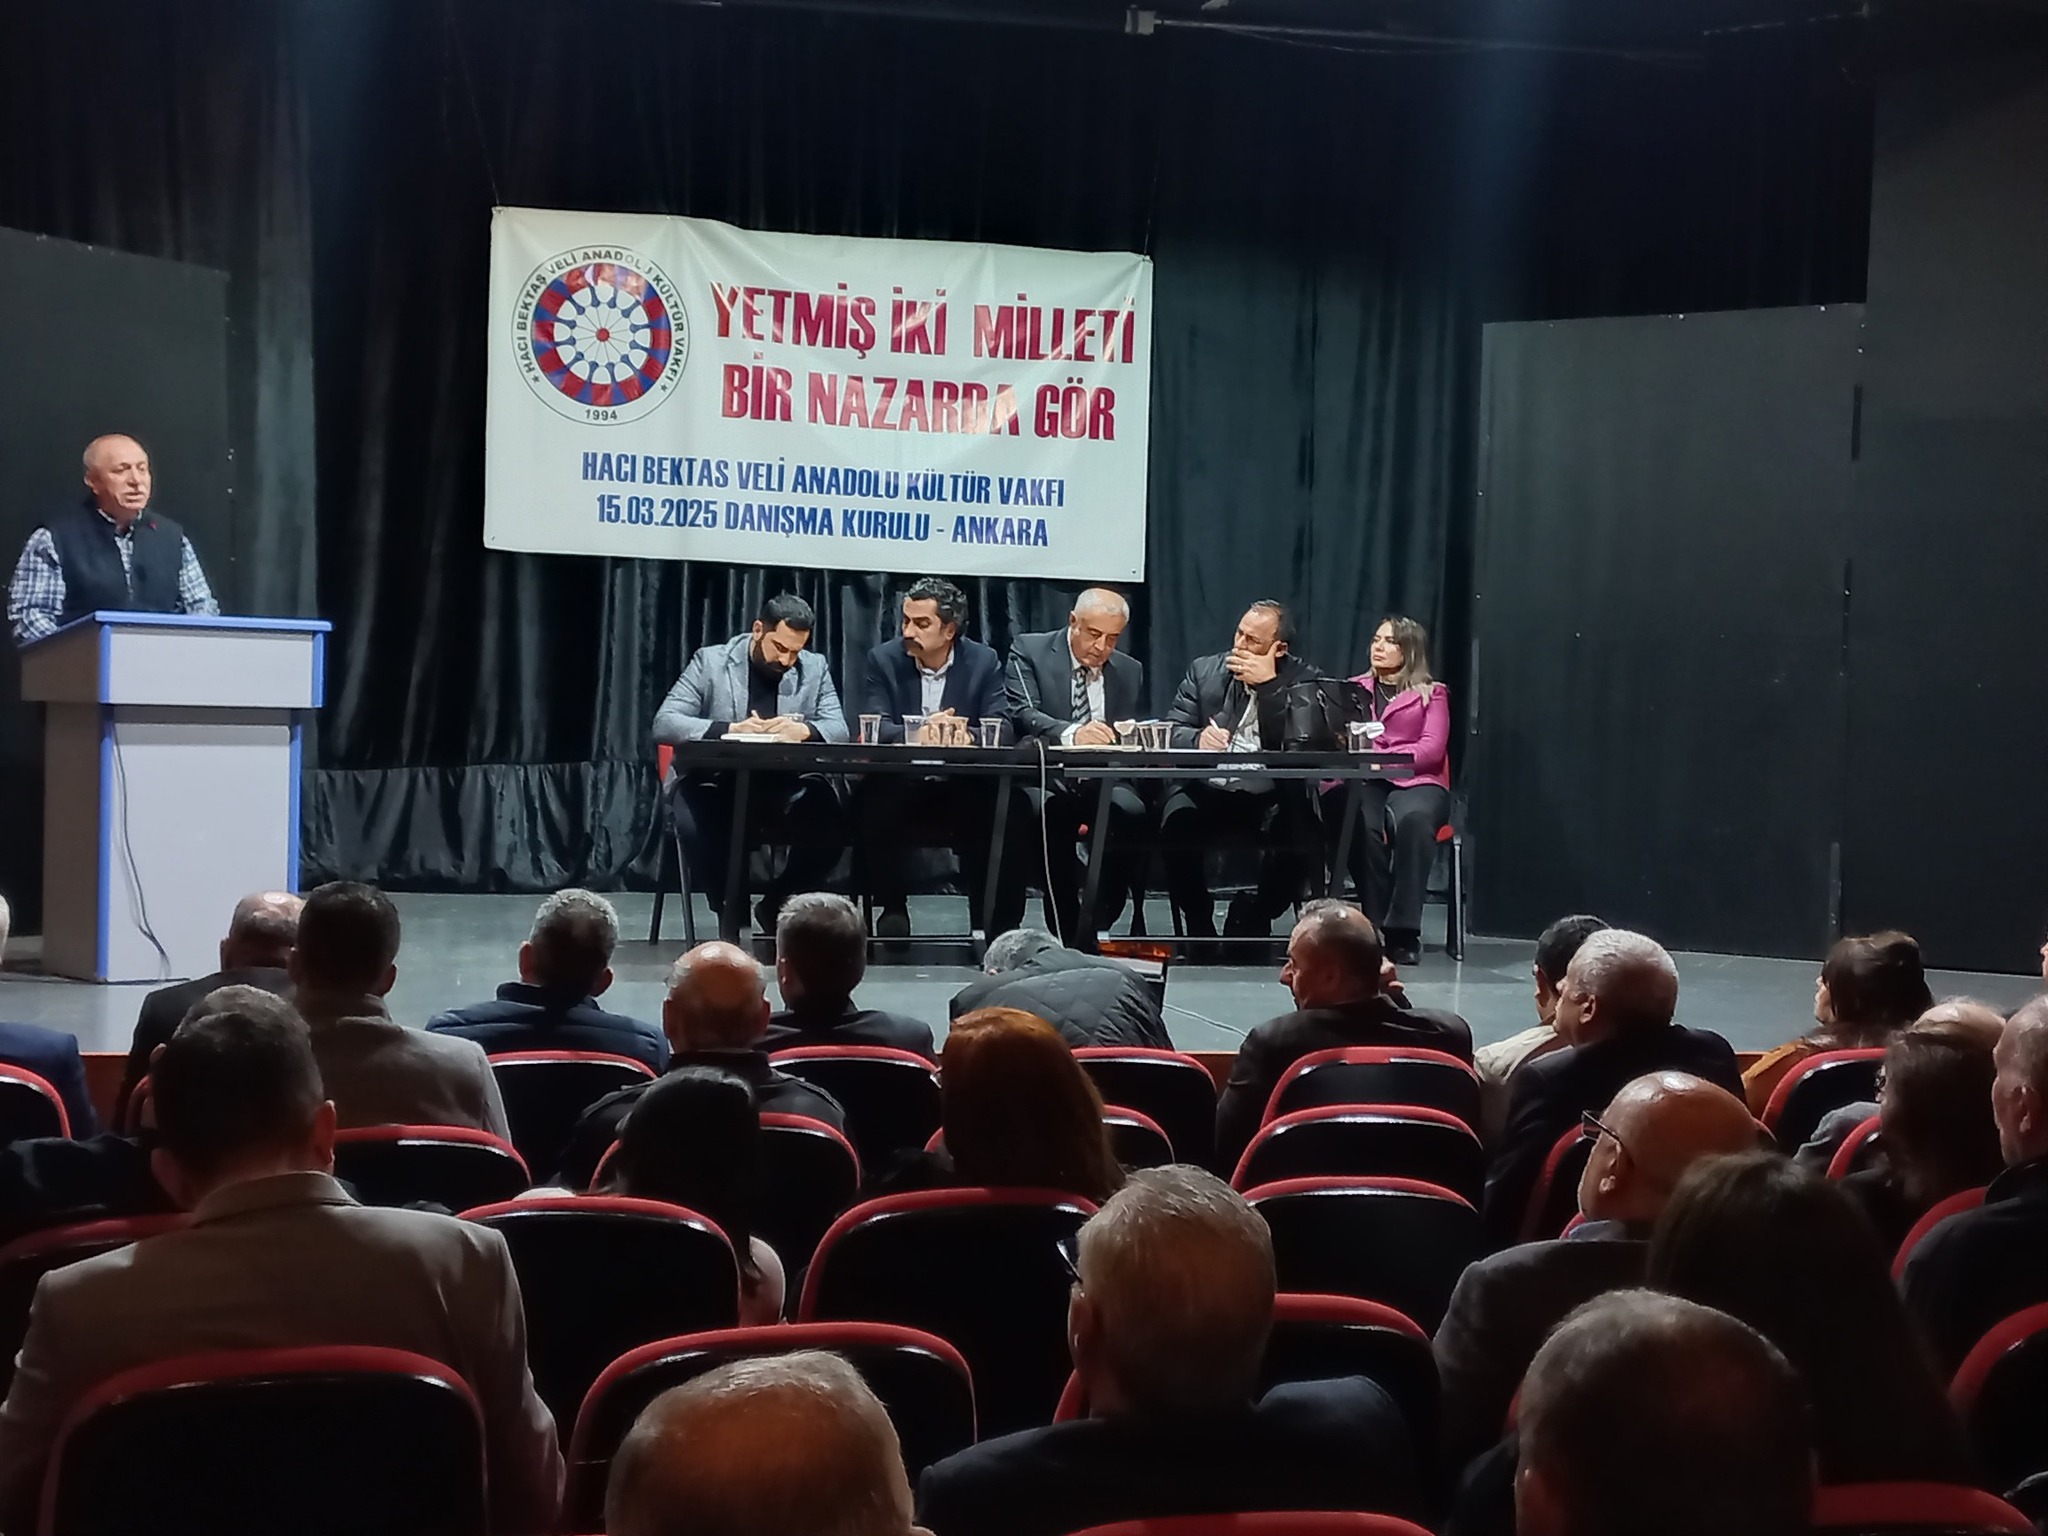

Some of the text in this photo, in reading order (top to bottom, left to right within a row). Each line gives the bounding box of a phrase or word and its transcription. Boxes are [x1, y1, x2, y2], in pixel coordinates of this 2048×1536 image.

[546, 252, 578, 275] VELİ
[517, 274, 547, 331] BEKTAŞ
[652, 274, 685, 333] KÜLTÜR
[710, 281, 1135, 364] YETMİŞ İKİ MİLLETİ
[517, 336, 536, 373] HACI
[664, 338, 685, 383] VAKFI
[585, 409, 618, 421] 1994
[722, 351, 1115, 441] BİR NAZARDA GÖR
[582, 452, 1064, 507] HACI BEKTAS VELİ ANADOLU KÜLTÜR VAKFI
[597, 494, 717, 529] 15.03.2025
[724, 501, 834, 538] DANIŞMA
[841, 509, 930, 541] KURULU
[951, 515, 1049, 547] ANKARA
